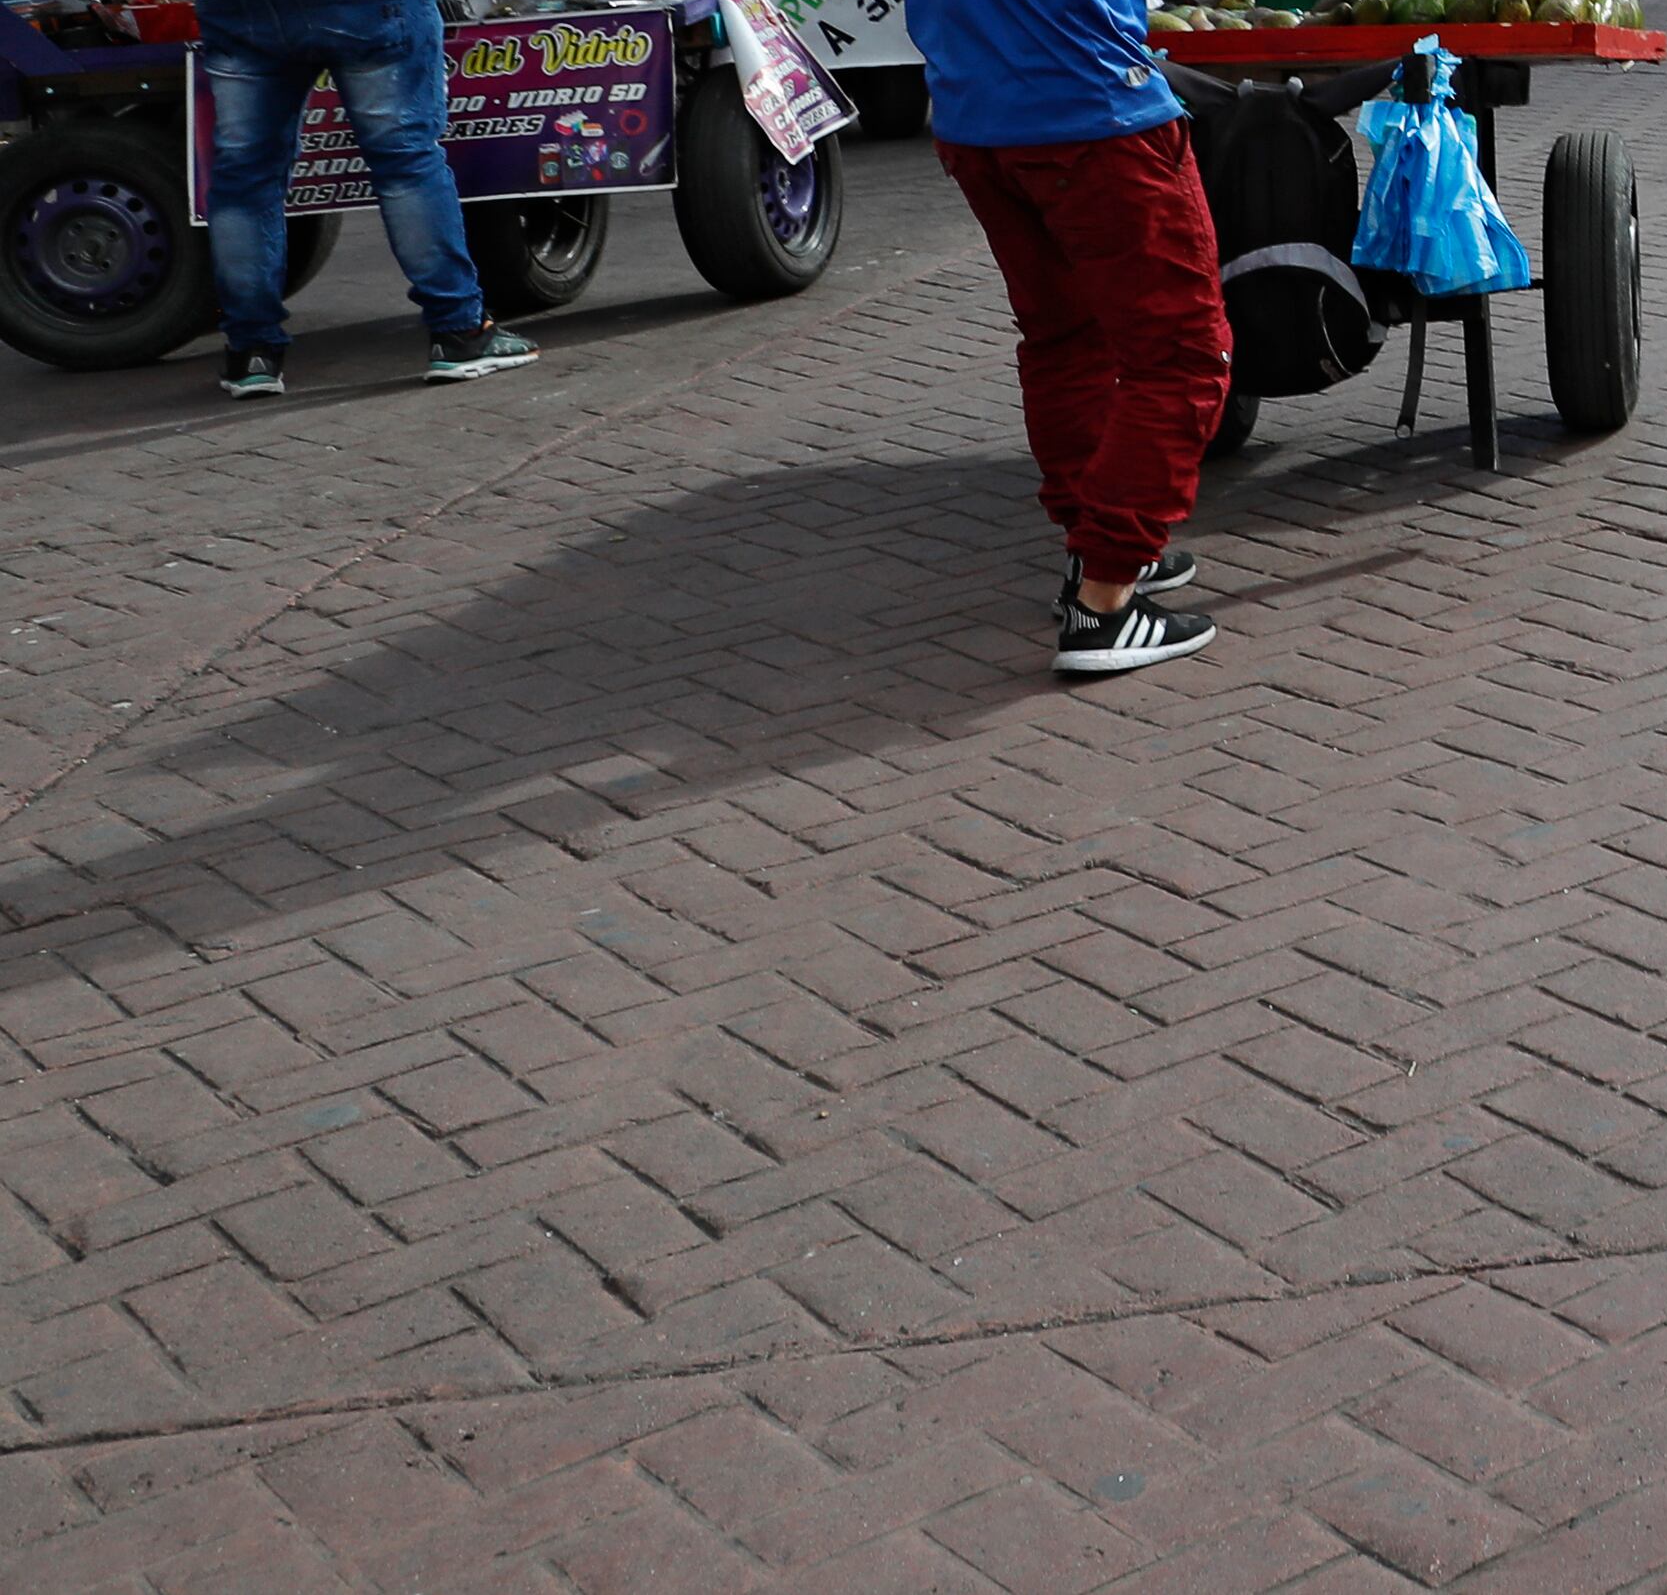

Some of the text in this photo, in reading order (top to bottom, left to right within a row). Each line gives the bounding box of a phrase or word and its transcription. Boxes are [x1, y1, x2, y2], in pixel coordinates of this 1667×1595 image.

[463, 23, 653, 78] del Vidrio
[507, 86, 603, 110] VIDRIO
